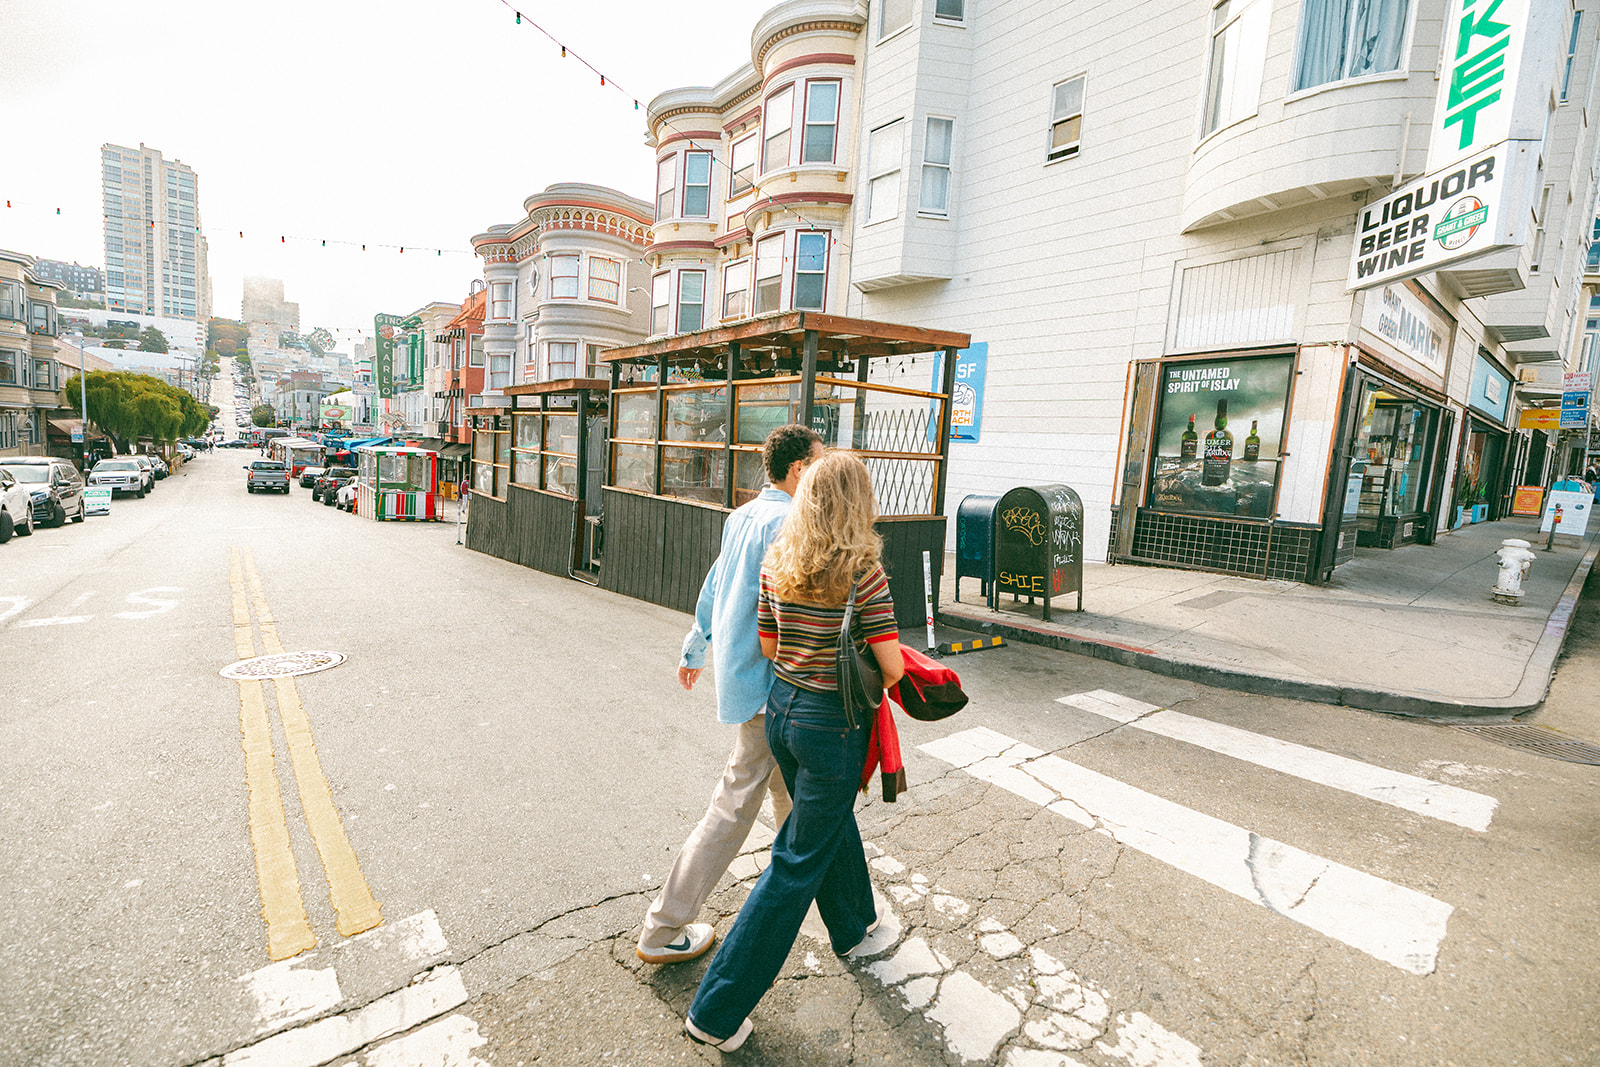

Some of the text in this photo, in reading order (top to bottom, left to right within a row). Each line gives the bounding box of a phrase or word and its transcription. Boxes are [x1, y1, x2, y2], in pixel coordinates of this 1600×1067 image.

[1443, 0, 1511, 151] KET
[1362, 156, 1495, 233] LIQUOR
[1358, 213, 1429, 257] BEER
[1436, 221, 1458, 236] GRANT
[1463, 210, 1486, 226] GREEN
[1357, 239, 1426, 279] WINE
[1383, 286, 1402, 314] GRANT
[376, 315, 403, 326] GINO
[1379, 313, 1398, 341] GREEN
[1399, 307, 1442, 363] MARKET
[382, 341, 391, 395] CARLO
[1169, 367, 1230, 382] THE UNTAMED
[1167, 378, 1240, 393] SPIRIT OF ISLAY
[953, 409, 971, 418] RTH
